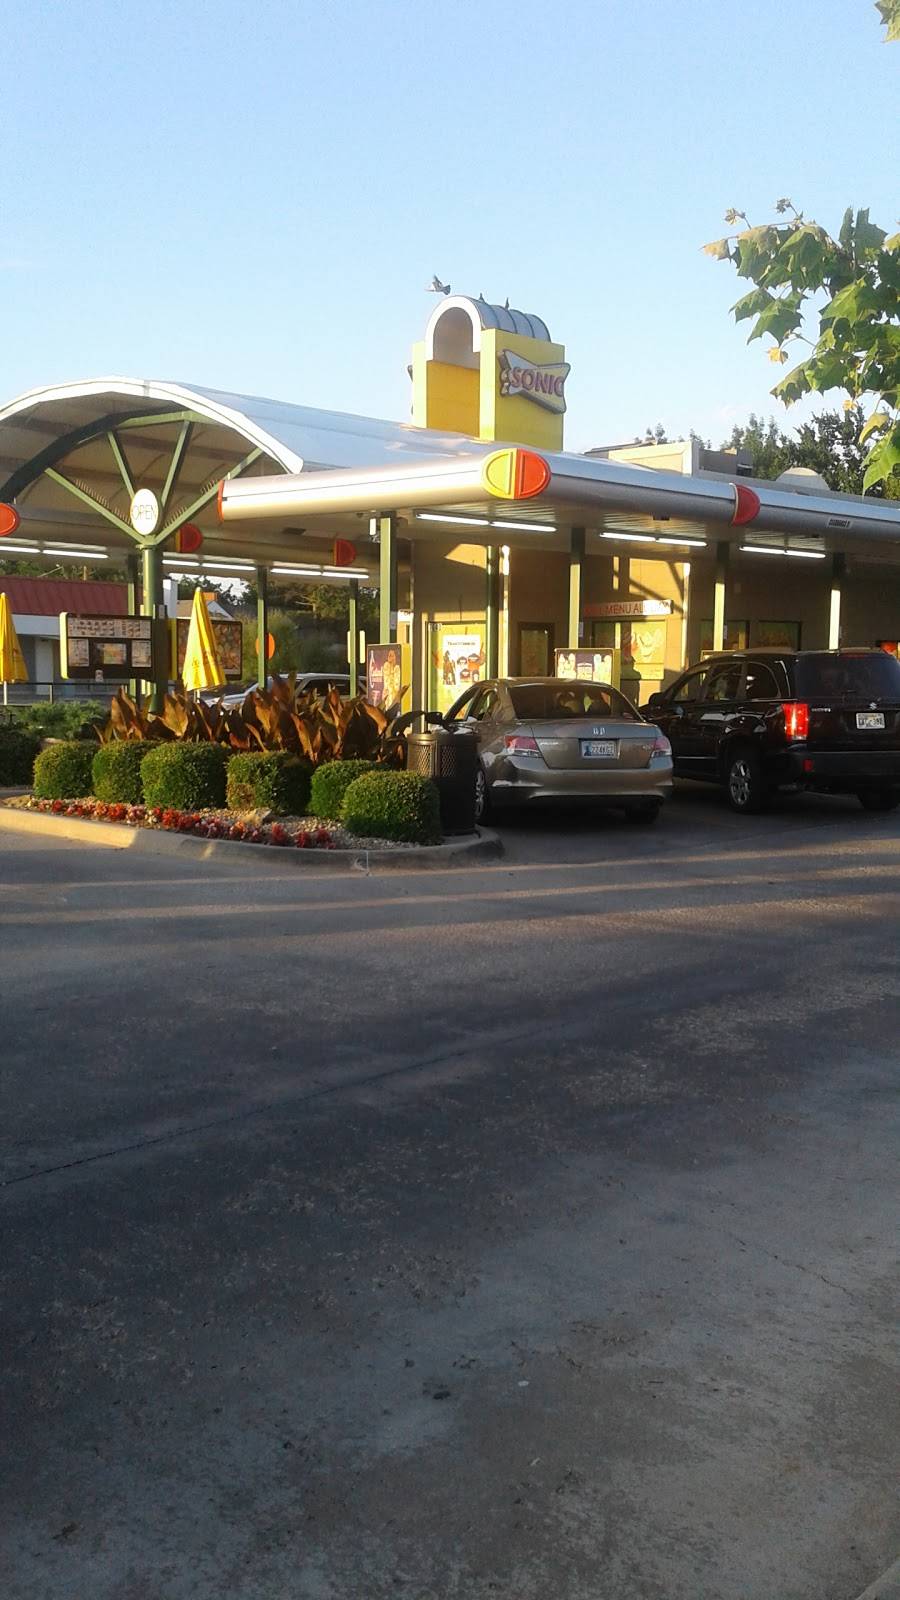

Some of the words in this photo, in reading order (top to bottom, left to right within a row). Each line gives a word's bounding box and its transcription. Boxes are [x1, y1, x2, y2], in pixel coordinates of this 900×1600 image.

[511, 366, 564, 397] SONIC
[131, 504, 157, 521] OPEN
[606, 602, 632, 614] MENU
